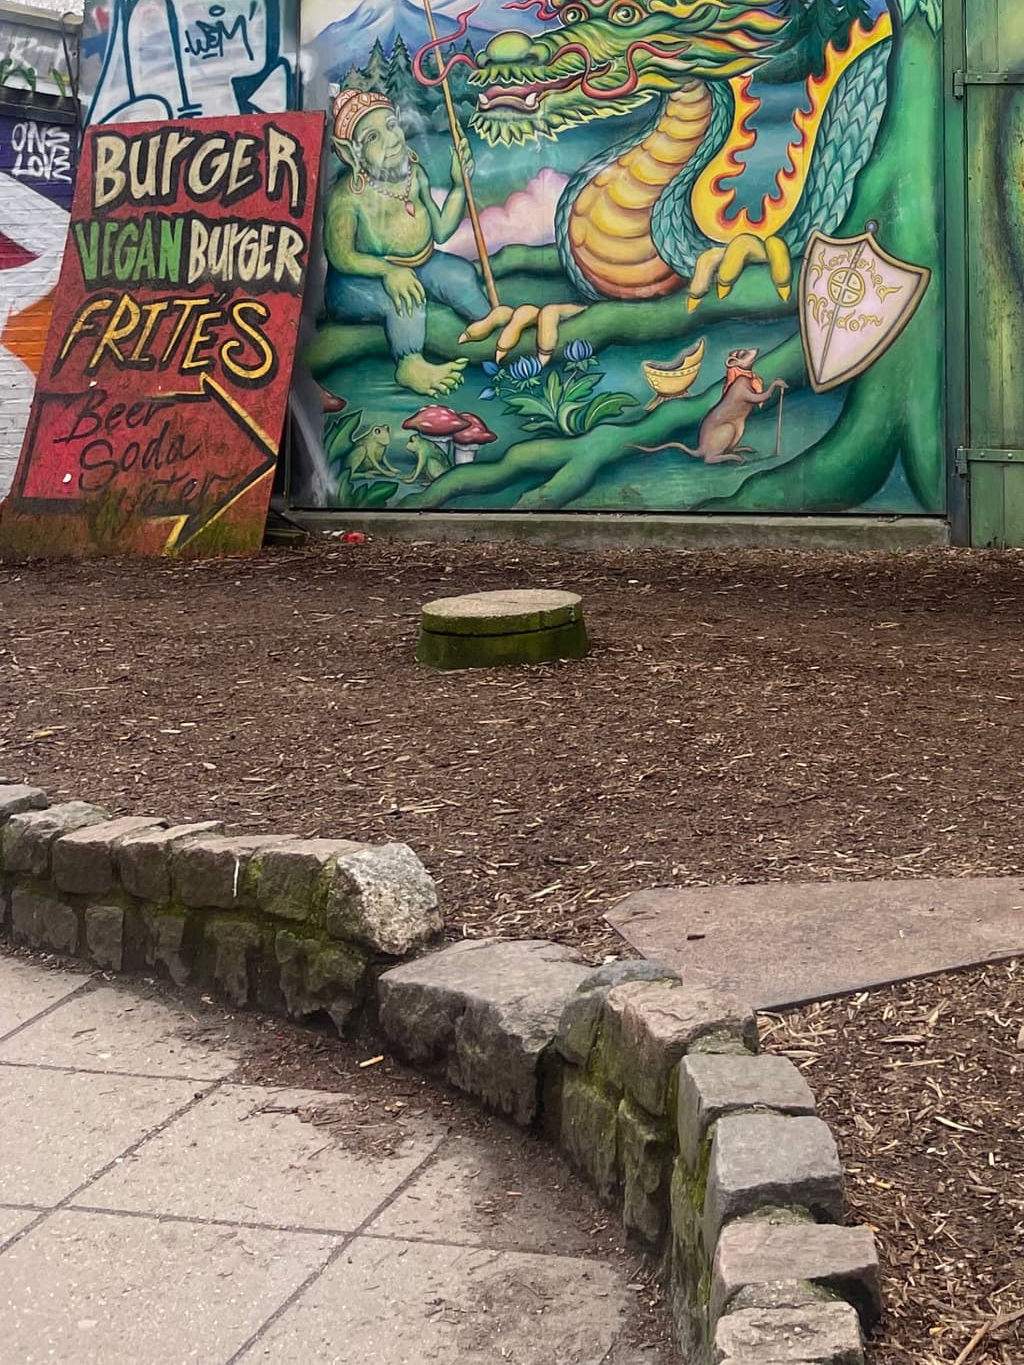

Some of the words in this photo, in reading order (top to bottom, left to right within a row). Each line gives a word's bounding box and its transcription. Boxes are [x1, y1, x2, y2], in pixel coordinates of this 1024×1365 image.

[74, 217, 185, 284] VEGAN
[53, 388, 176, 444] Beer
[79, 420, 201, 493] Soda
